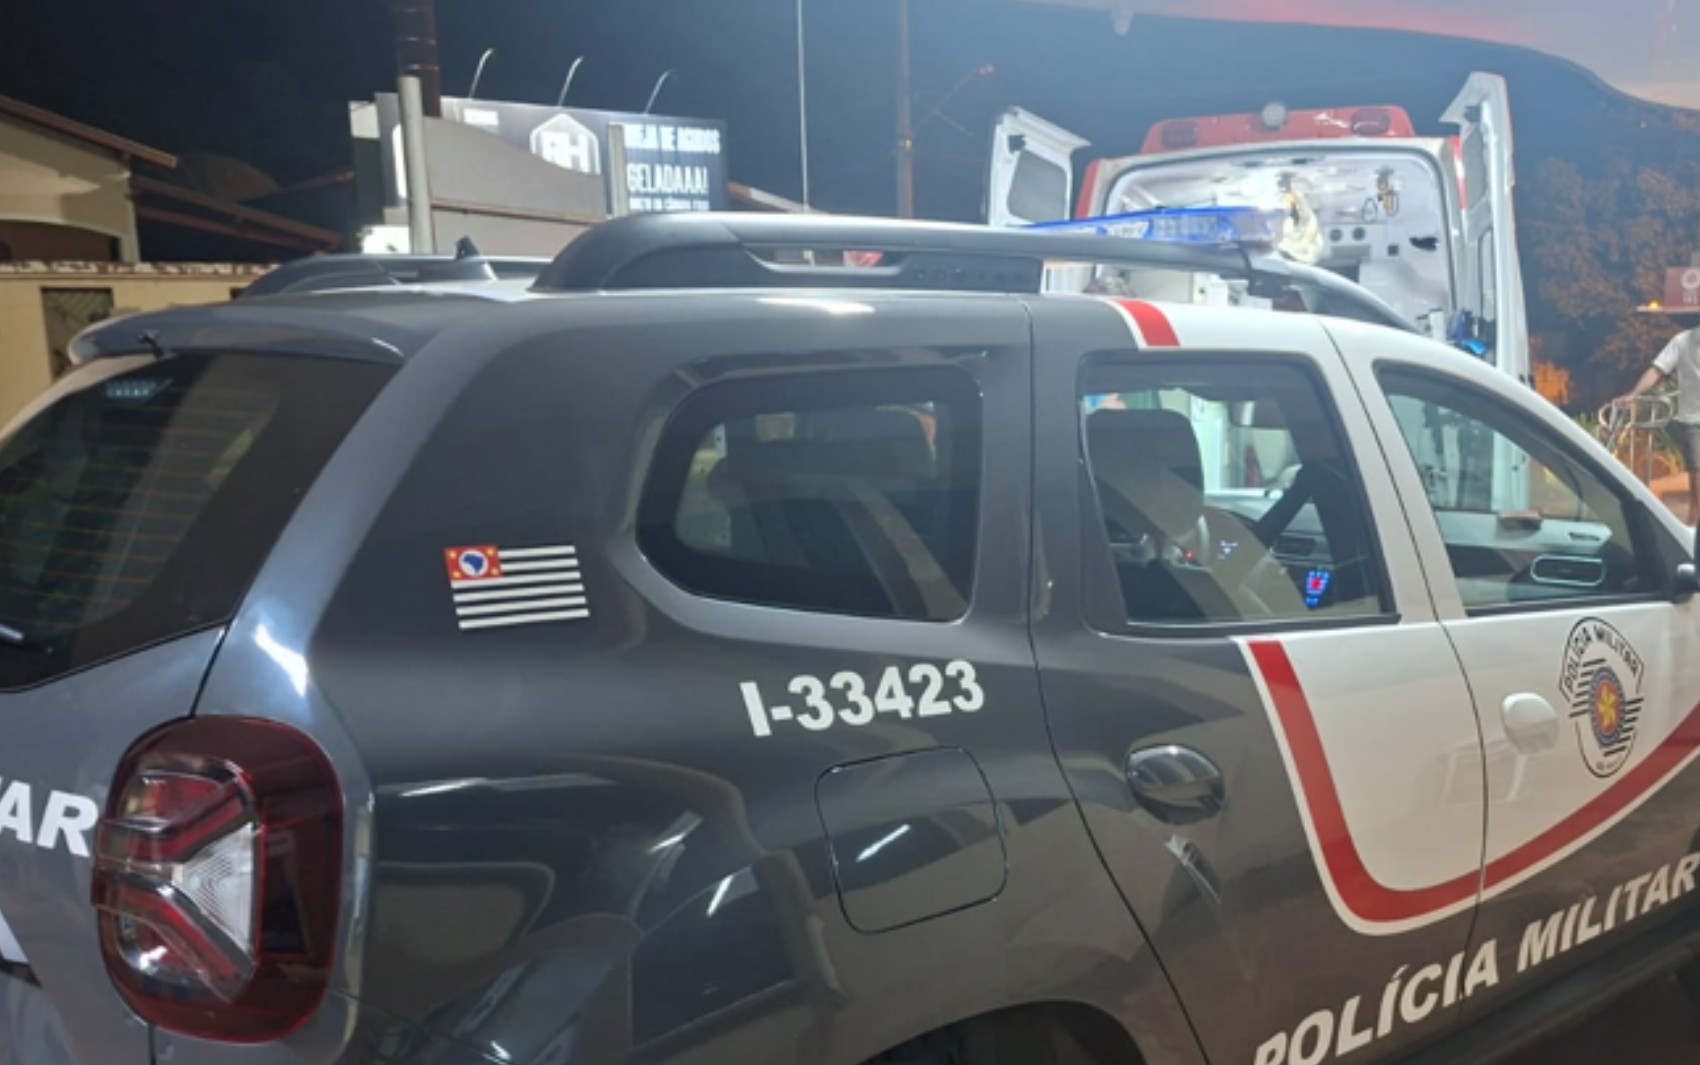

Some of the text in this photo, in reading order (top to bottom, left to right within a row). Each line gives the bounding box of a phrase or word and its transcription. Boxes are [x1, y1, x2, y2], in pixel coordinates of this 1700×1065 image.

[1593, 624, 1639, 678] MILITAR
[739, 659, 985, 736] I-33423
[0, 777, 99, 857] AR
[1253, 851, 1700, 1065] POLÍCIA MILITAR
